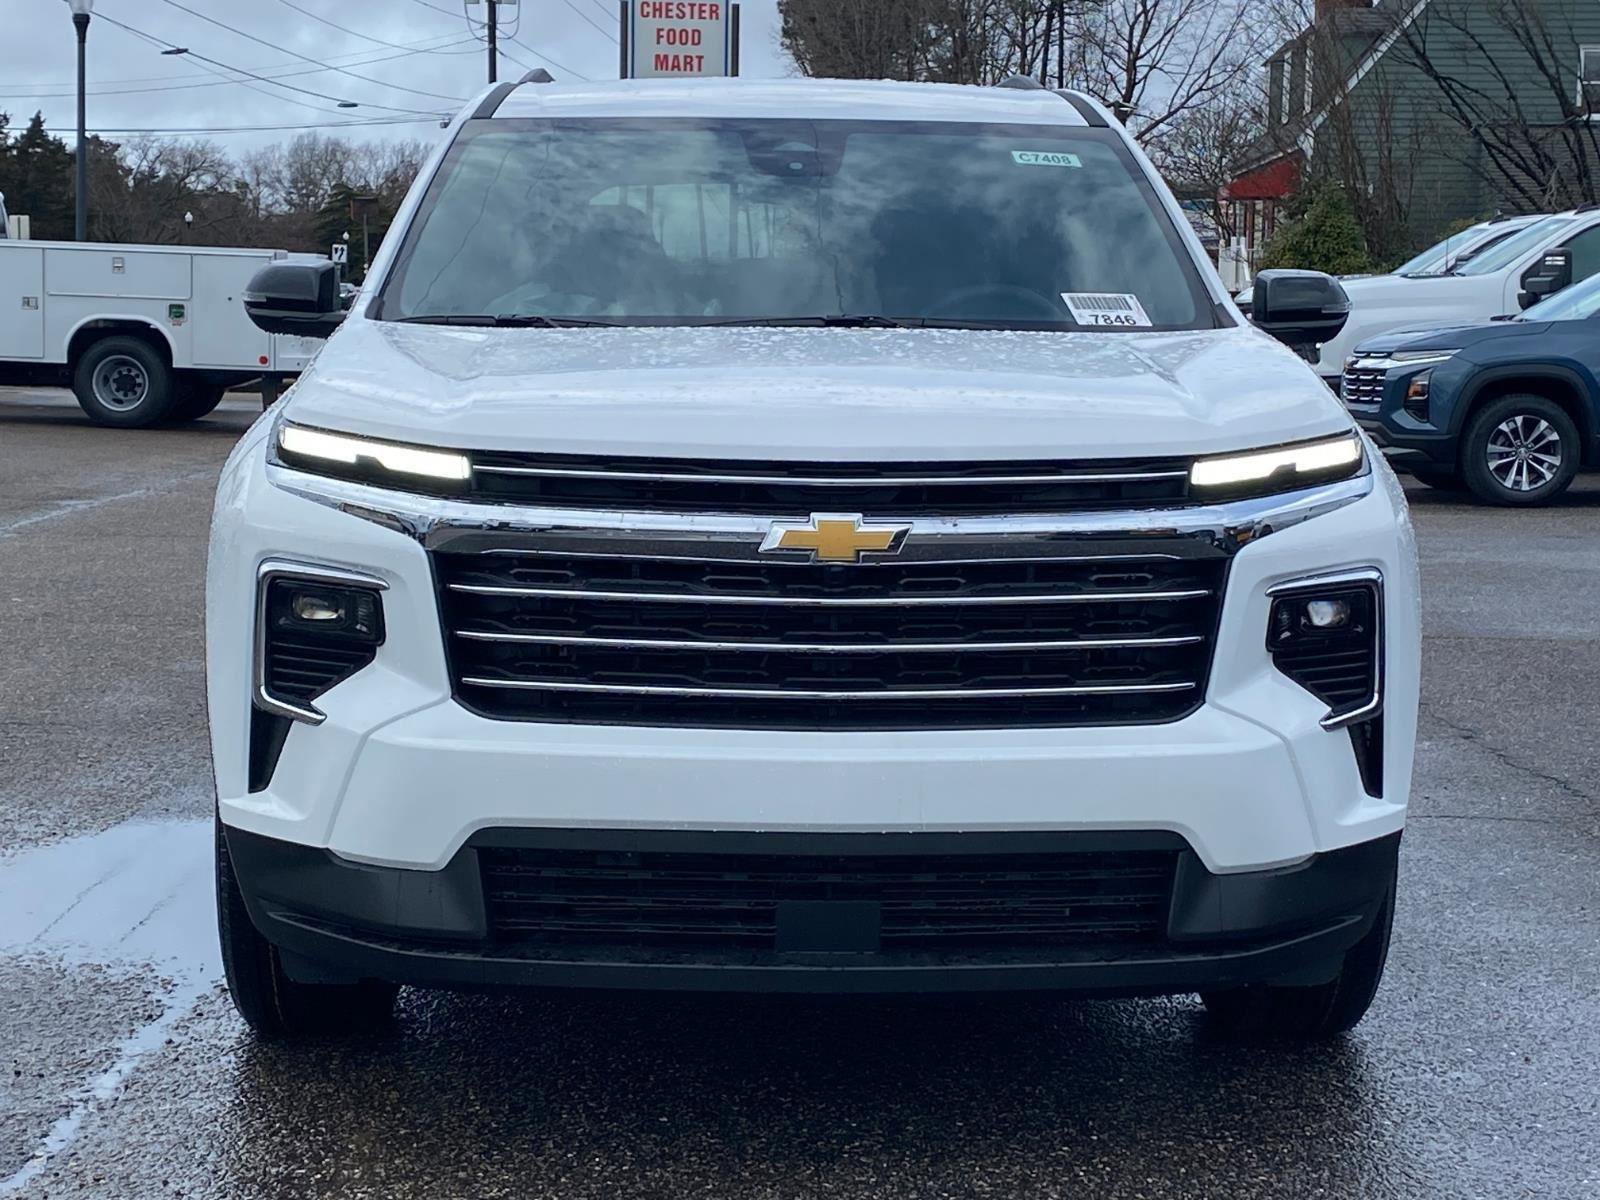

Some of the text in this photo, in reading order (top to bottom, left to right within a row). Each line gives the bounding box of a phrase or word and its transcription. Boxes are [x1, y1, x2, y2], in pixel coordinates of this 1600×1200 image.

[640, 1, 720, 20] CHESTER
[656, 28, 701, 46] FOOD
[654, 54, 704, 72] MART
[1019, 153, 1071, 165] C7408
[1089, 314, 1137, 326] 7846
